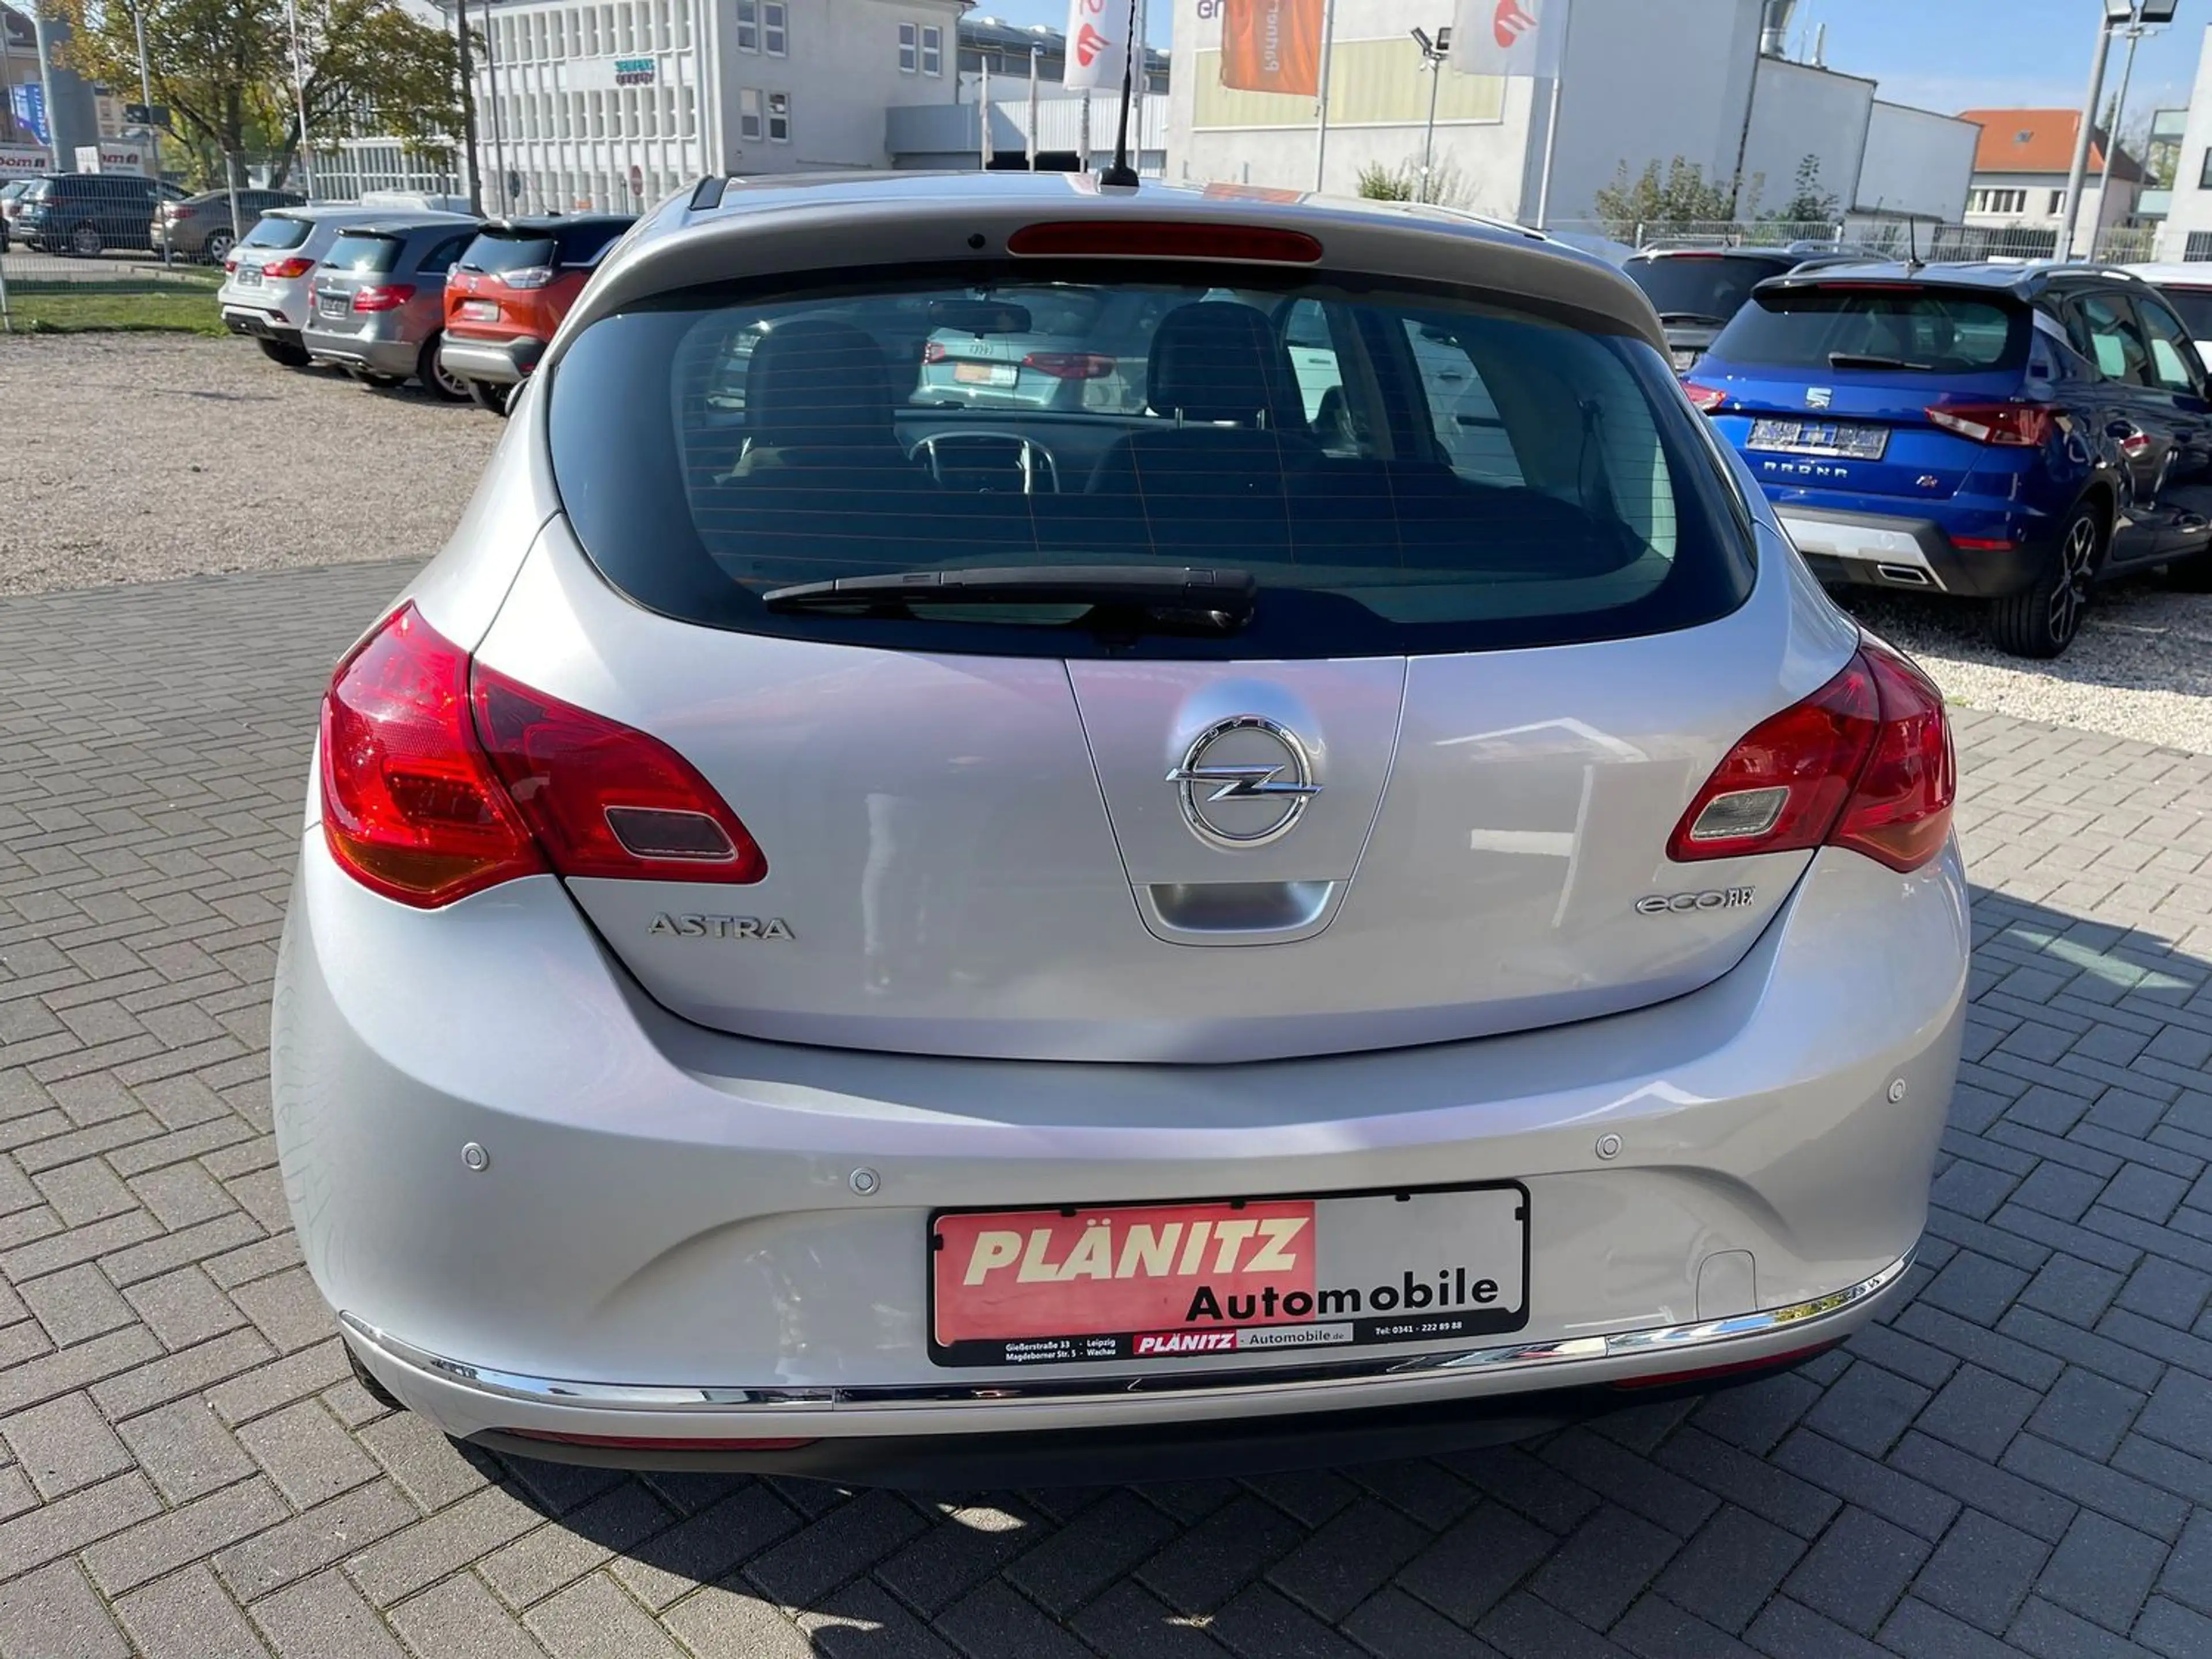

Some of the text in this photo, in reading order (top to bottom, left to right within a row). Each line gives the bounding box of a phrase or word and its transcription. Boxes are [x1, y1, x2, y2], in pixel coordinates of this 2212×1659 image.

[1764, 461, 1848, 478] ARONA
[647, 910, 796, 941] ASTRA
[963, 1217, 1310, 1285] PLÄNITZ
[1185, 1267, 1498, 1322] Automobile
[1392, 1325, 1413, 1334] 0341
[1421, 1323, 1437, 1332] 222
[1086, 1338, 1116, 1348] Leipzig
[1138, 1332, 1235, 1353] PLÄNITZ
[1071, 1349, 1076, 1358] 5
[1086, 1348, 1116, 1356] Wachau
